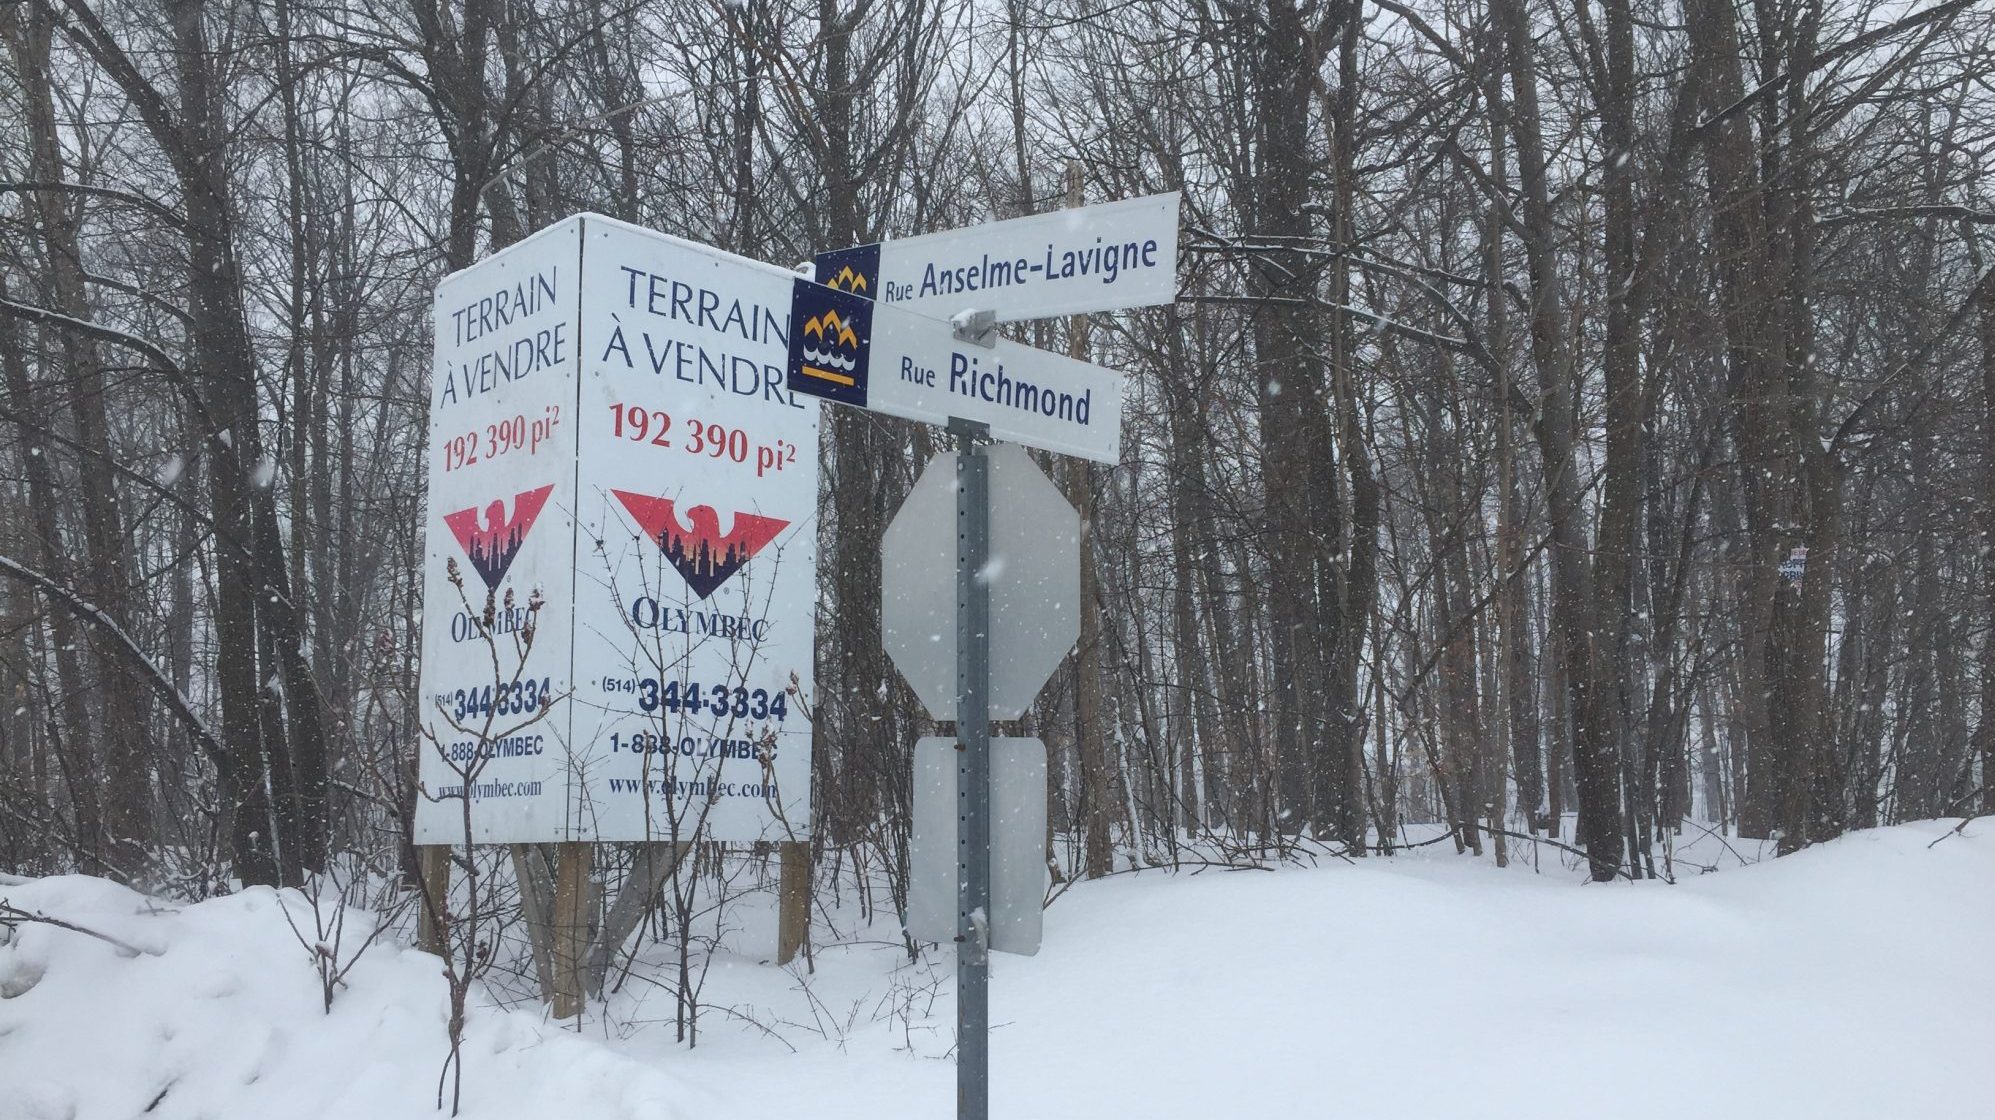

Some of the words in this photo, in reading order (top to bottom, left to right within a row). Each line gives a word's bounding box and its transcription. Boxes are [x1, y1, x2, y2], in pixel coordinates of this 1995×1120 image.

[885, 280, 913, 302] Rue
[919, 237, 1157, 298] Anselme-Lavigne
[452, 266, 557, 347] TERRAIN
[620, 265, 790, 349] TERRAIN
[440, 361, 457, 409] À
[463, 322, 567, 399] VENDRE
[602, 312, 634, 369] À
[900, 355, 936, 388] Rue
[949, 351, 1091, 425] Richmond
[443, 431, 477, 472] 192
[485, 414, 526, 460] 390
[609, 402, 671, 448] 192
[686, 418, 749, 465] 390
[632, 596, 769, 643] OLYMBEC
[454, 677, 550, 722] 3443334
[602, 675, 636, 694] (514)
[438, 777, 542, 800] wwwolymbec.com
